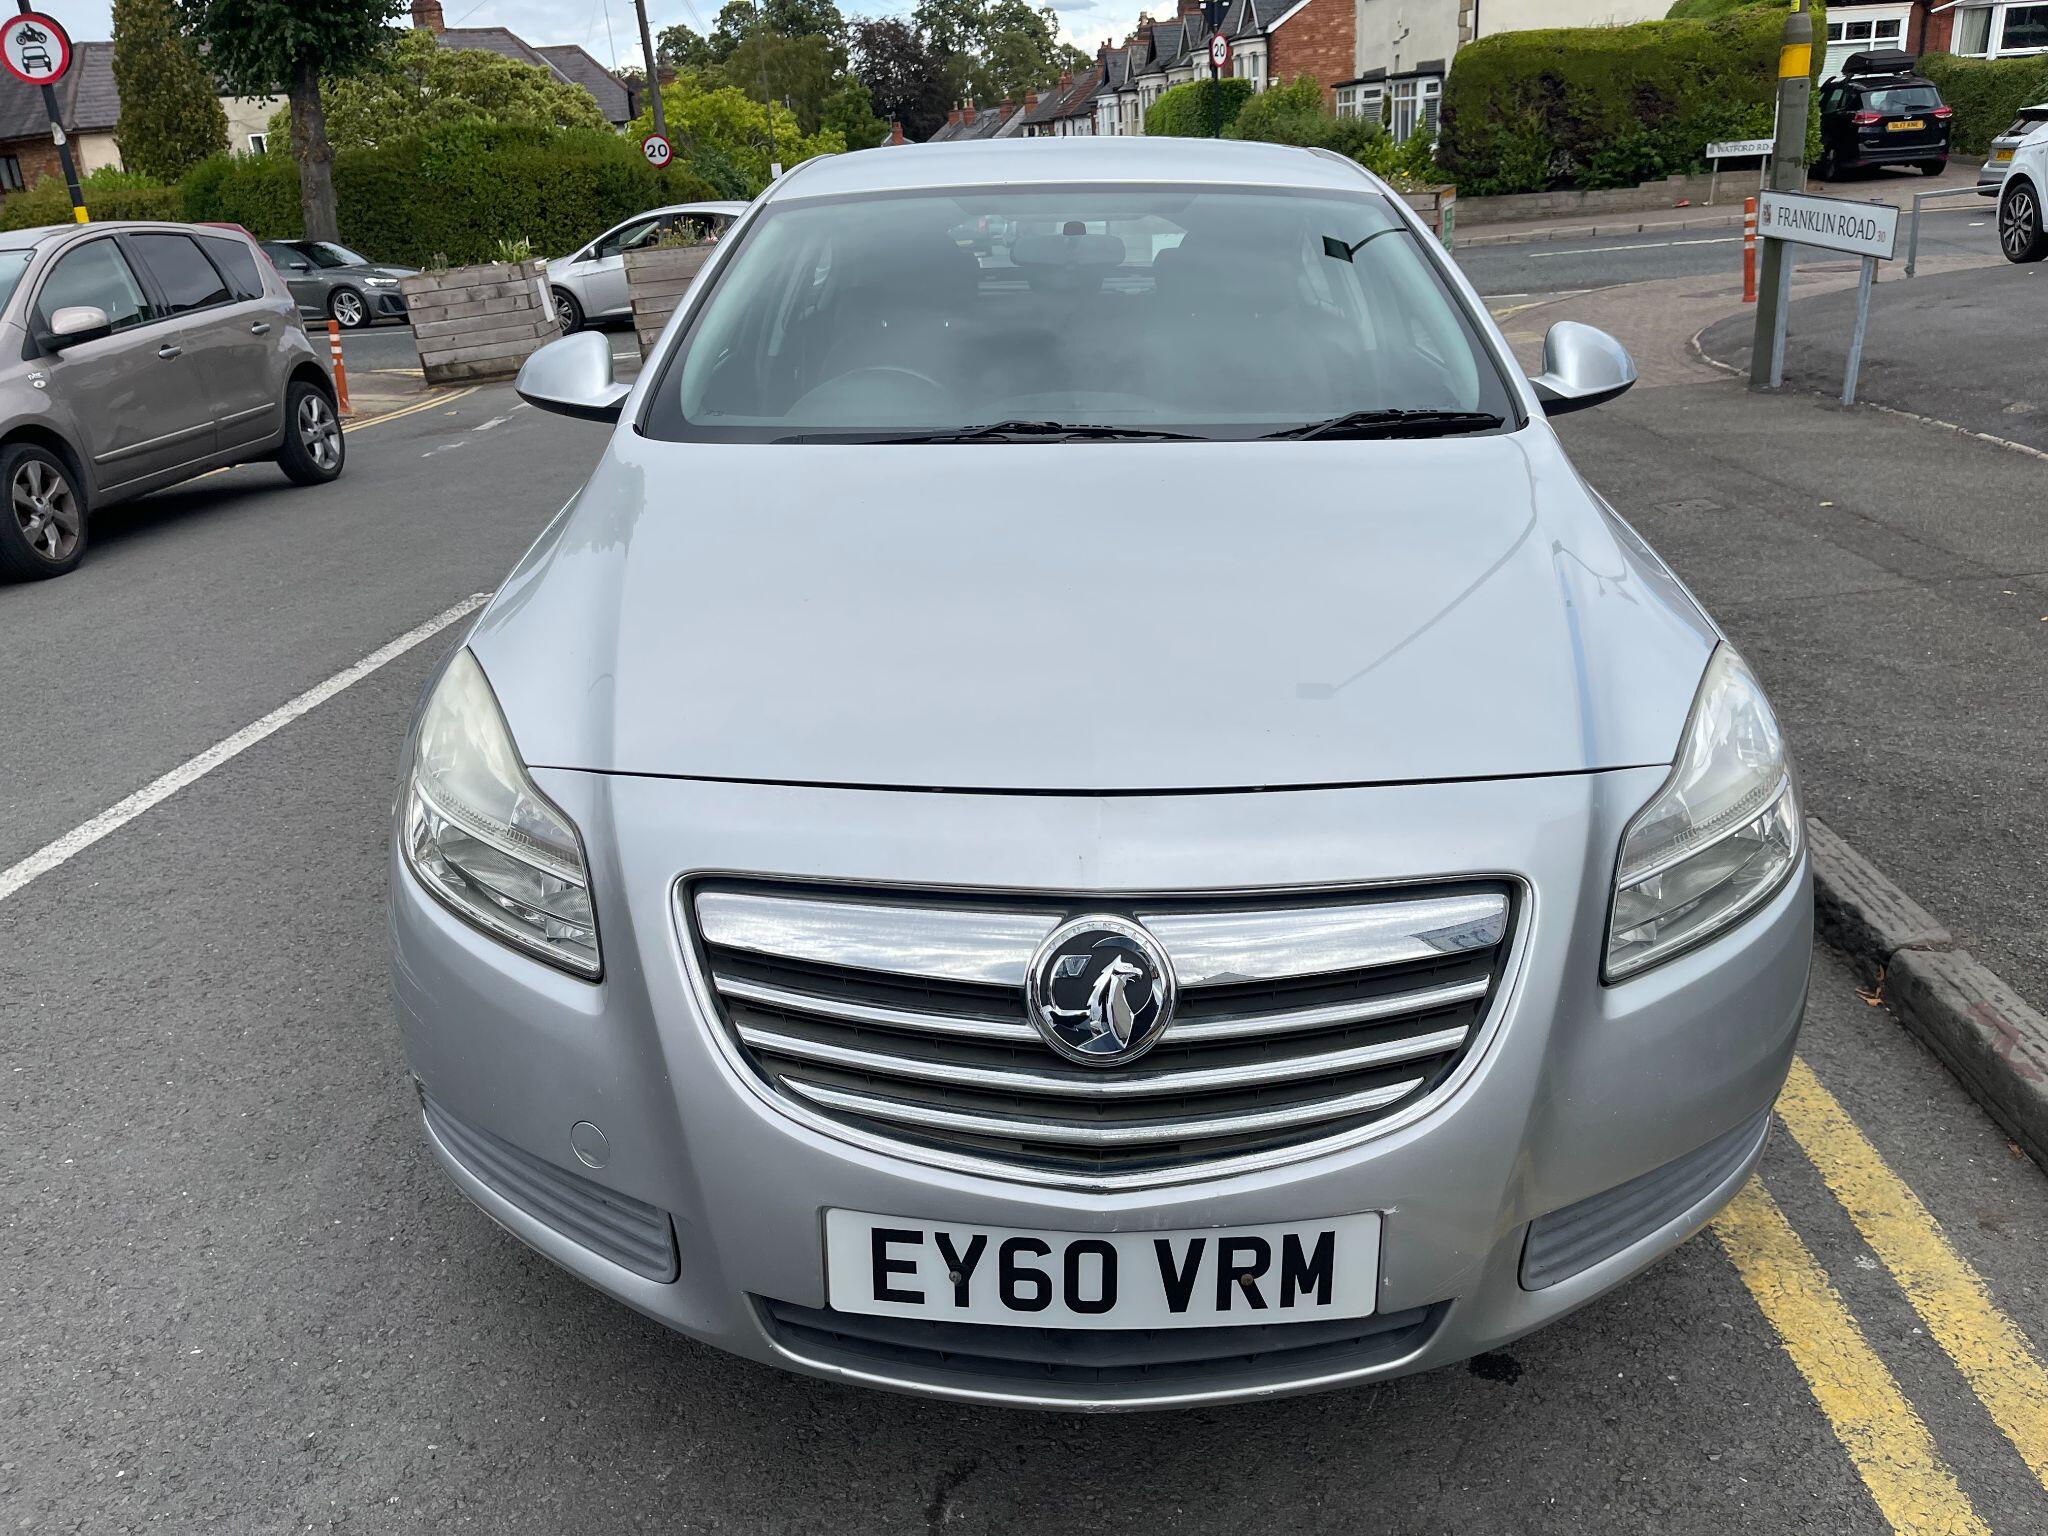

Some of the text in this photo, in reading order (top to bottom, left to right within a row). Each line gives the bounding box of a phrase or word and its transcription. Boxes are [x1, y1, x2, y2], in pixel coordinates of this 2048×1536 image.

[1214, 43, 1226, 58] 20
[646, 143, 668, 158] 20
[1756, 143, 1770, 151] RD
[1777, 207, 1887, 243] FRANKLIN ROAD 30
[871, 1227, 1336, 1315] EY60 VRM
